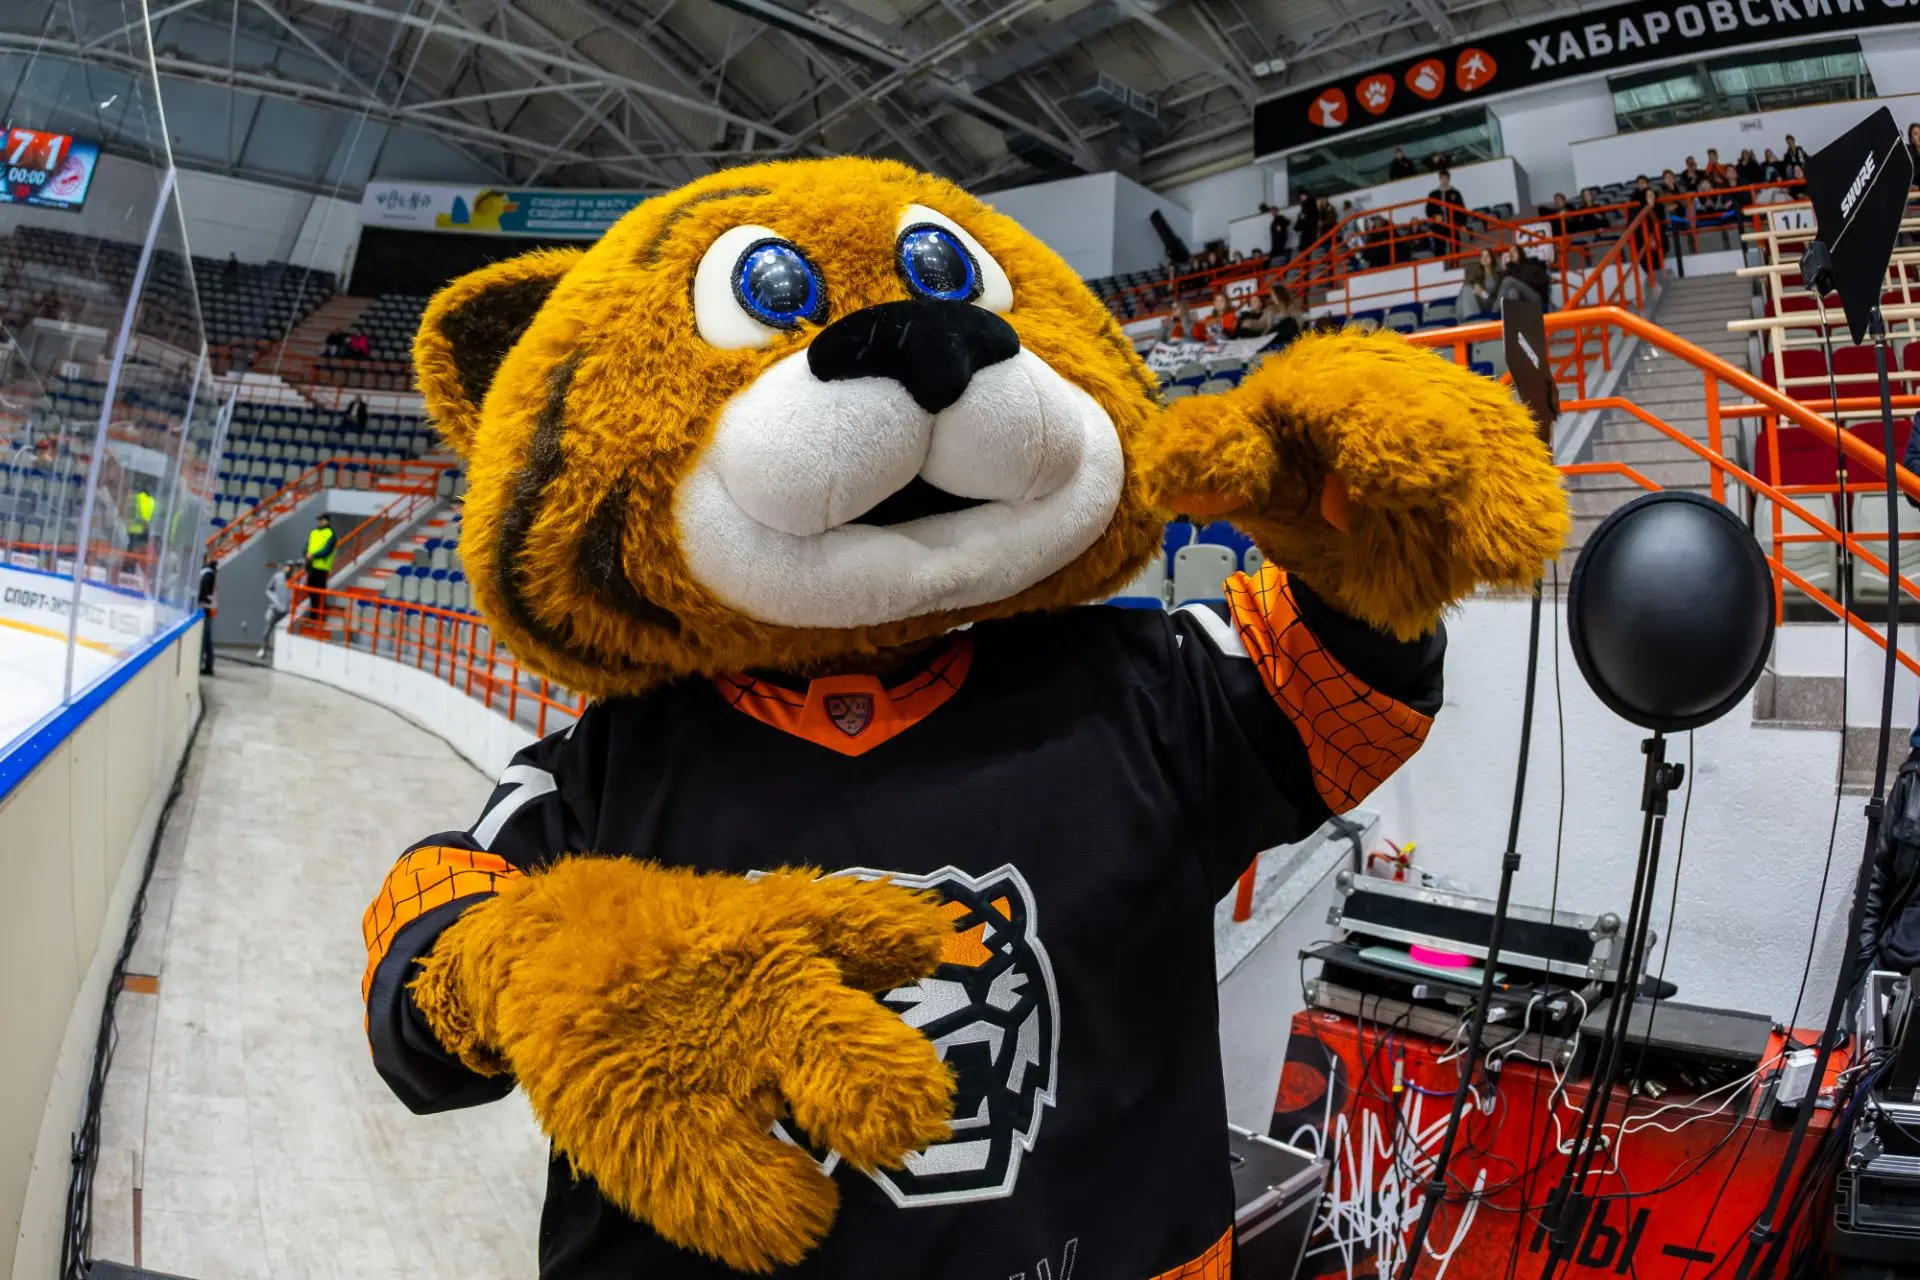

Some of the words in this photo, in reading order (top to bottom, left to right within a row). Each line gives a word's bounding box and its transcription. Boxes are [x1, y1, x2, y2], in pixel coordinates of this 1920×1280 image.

[8, 130, 36, 165] 7
[45, 134, 64, 170] 1
[8, 167, 47, 186] 00:00
[1841, 150, 1876, 219] SHURE
